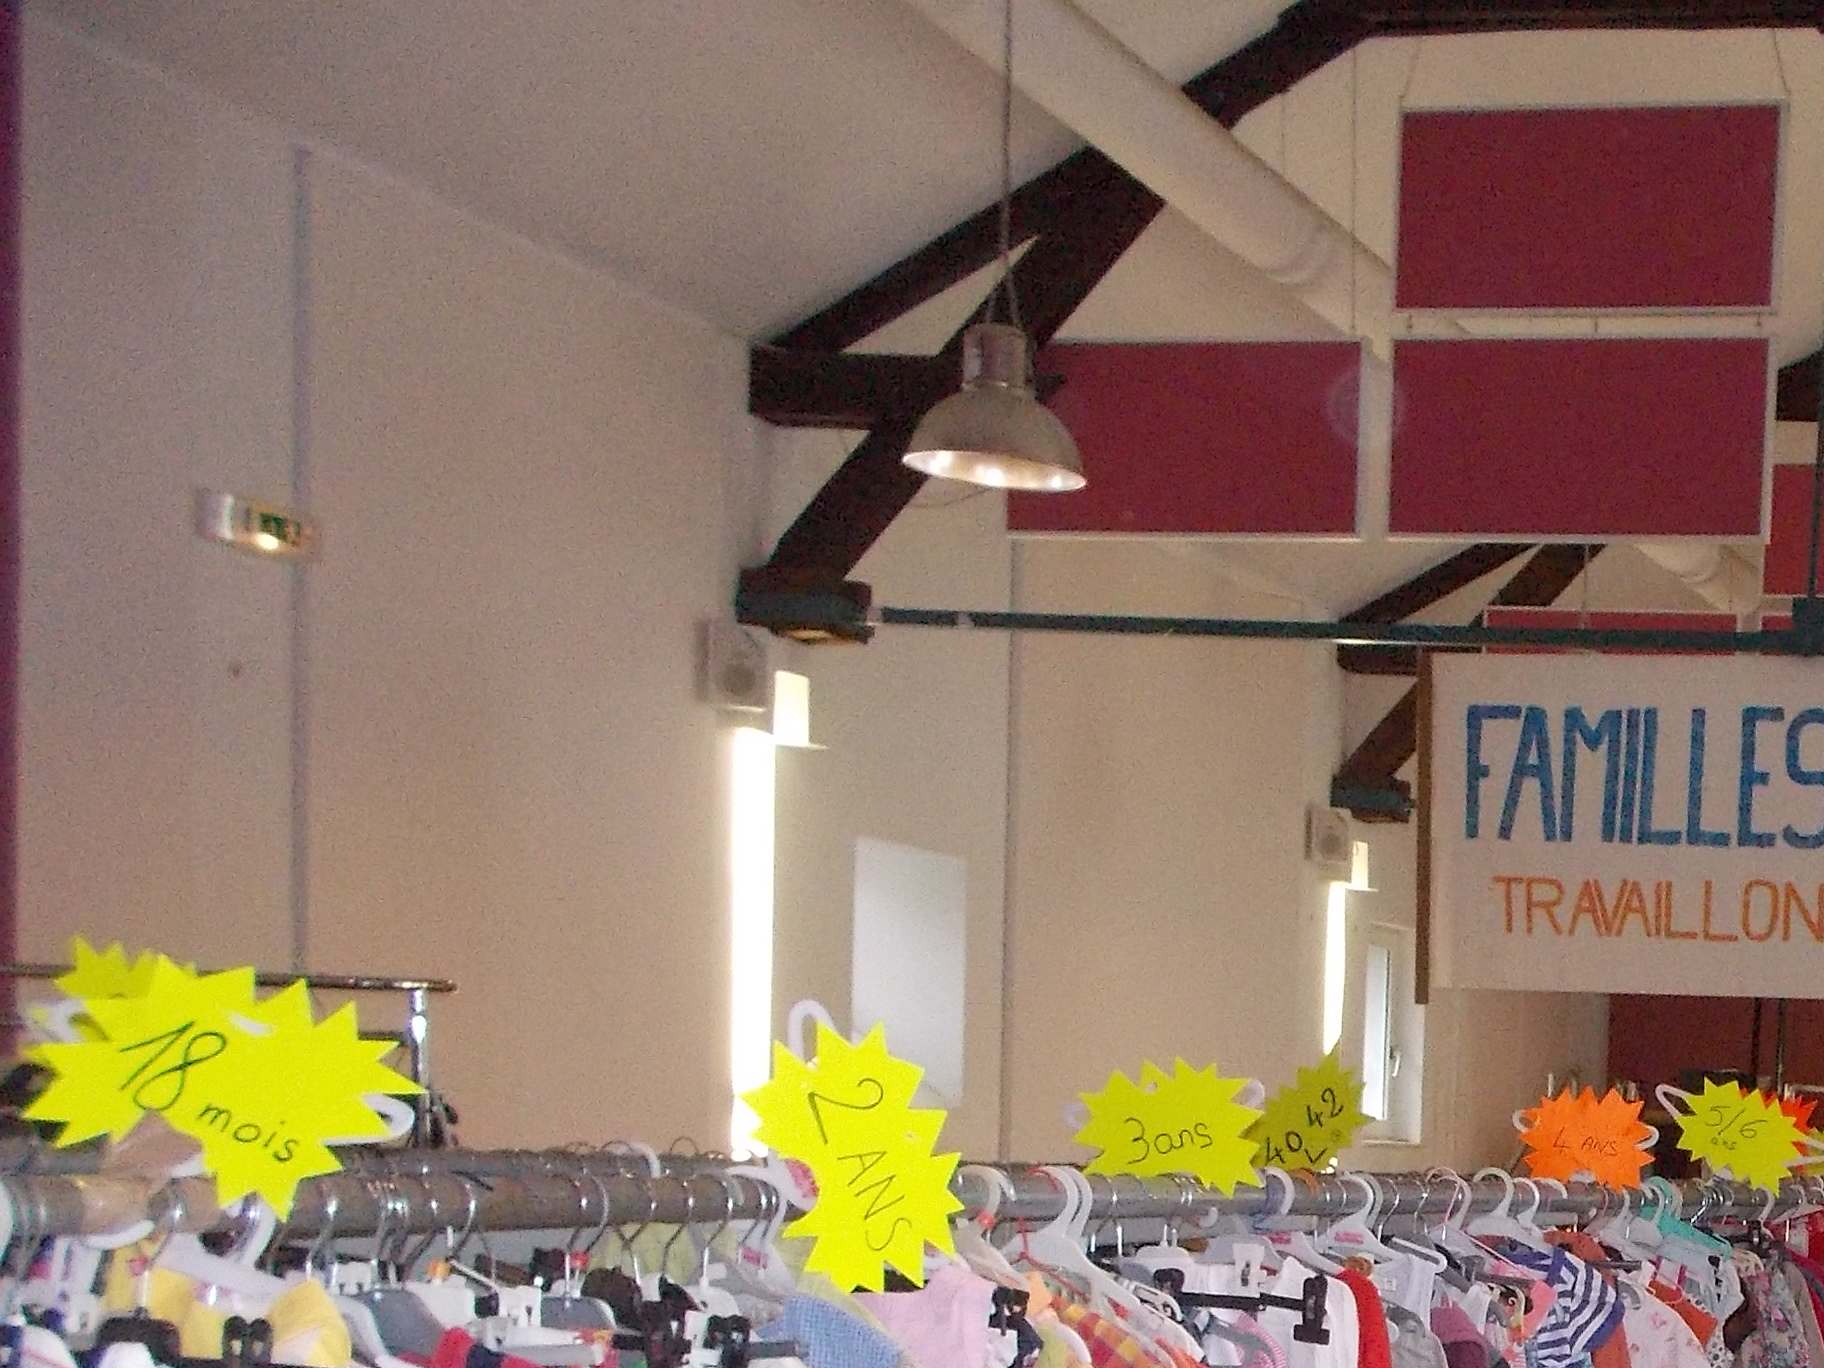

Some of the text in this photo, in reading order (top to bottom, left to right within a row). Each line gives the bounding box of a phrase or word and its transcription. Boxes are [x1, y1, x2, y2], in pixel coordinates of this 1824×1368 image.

[119, 1020, 227, 1111] 18
[196, 1101, 300, 1163] mois
[807, 1077, 884, 1145] 2
[1264, 1087, 1344, 1167] 40 42
[1551, 1128, 1567, 1155] 4
[1703, 1104, 1768, 1140] 5/6
[836, 1150, 913, 1251] ANS
